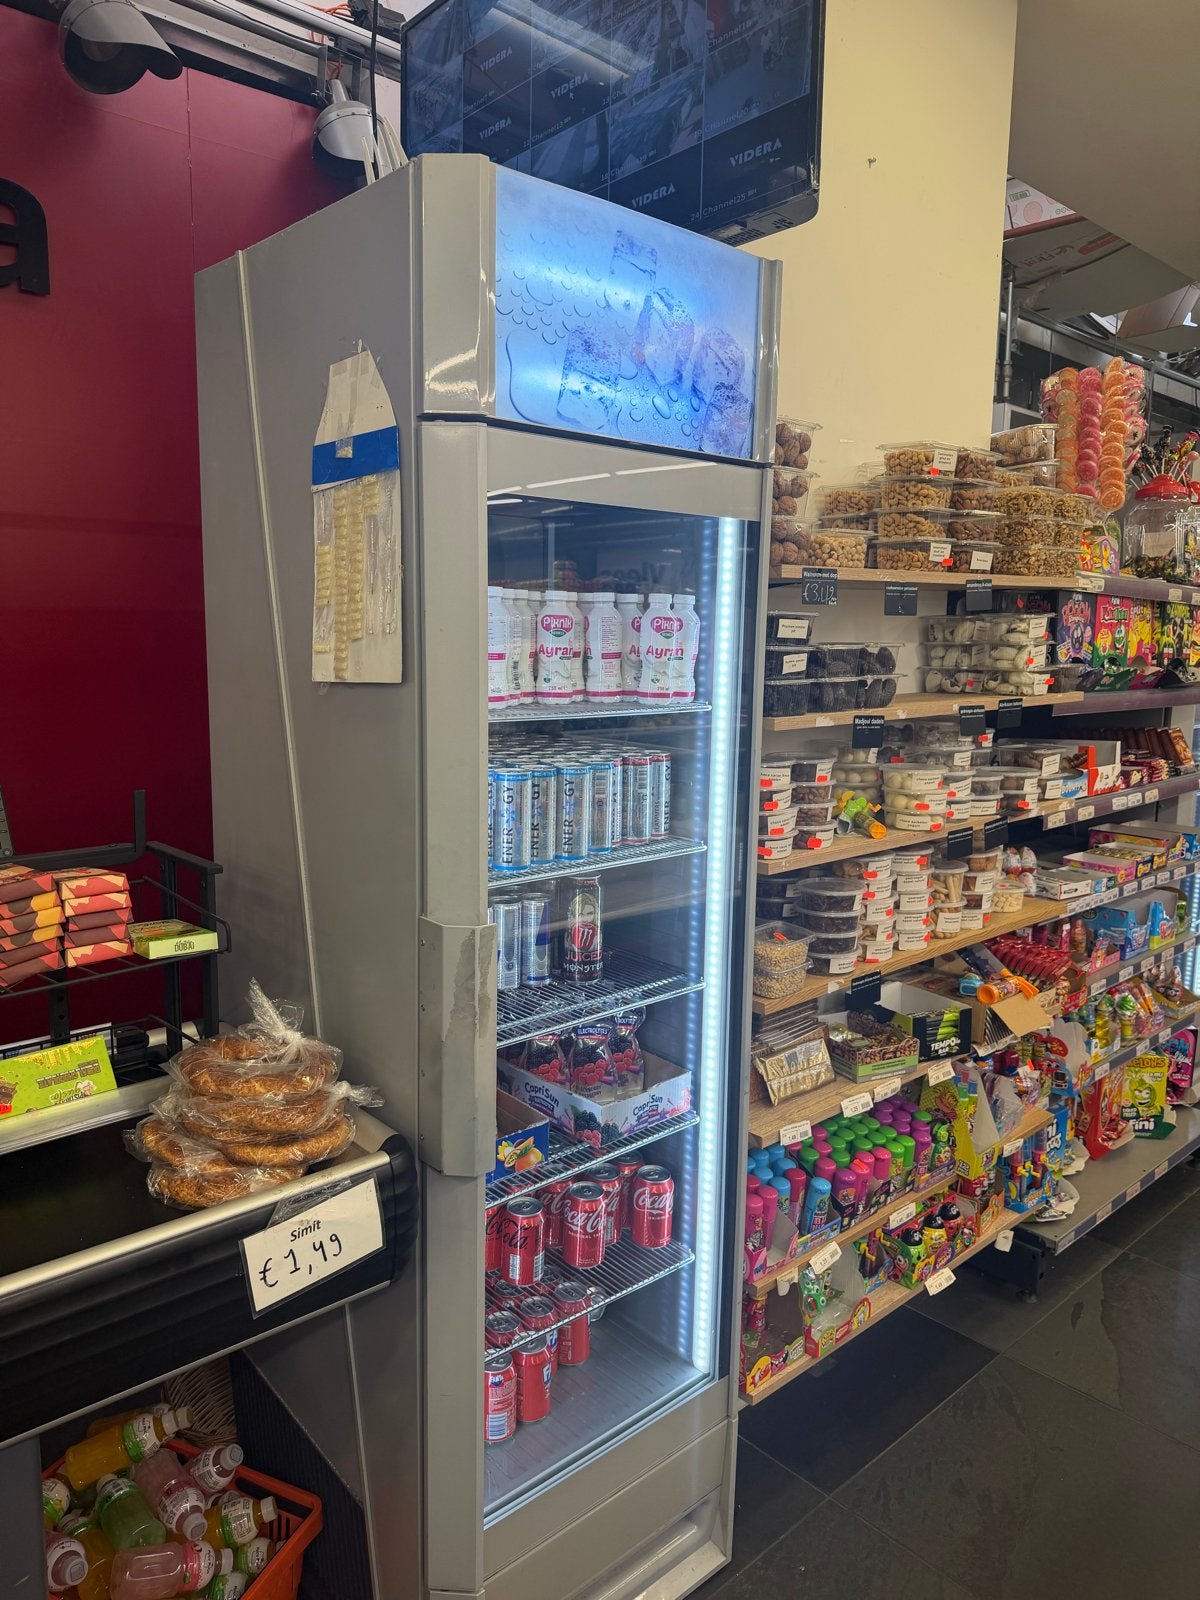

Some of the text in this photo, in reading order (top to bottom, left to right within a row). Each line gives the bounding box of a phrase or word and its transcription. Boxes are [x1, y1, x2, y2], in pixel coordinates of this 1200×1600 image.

[480, 46, 513, 73] VIDERA
[550, 72, 590, 99] VIDERA
[479, 116, 513, 141] VIDERA
[730, 137, 783, 168] VIDERA
[631, 182, 676, 209] VIDERA
[702, 192, 746, 217] Channel25
[543, 615, 573, 629] Piknik
[502, 785, 514, 864] ENER GY
[531, 782, 540, 858] ENER GY
[562, 778, 575, 854] ENER GY
[577, 1027, 609, 1035] ELECTROLYTES
[930, 1037, 956, 1051] TEMPO
[290, 1219, 322, 1242] Simit
